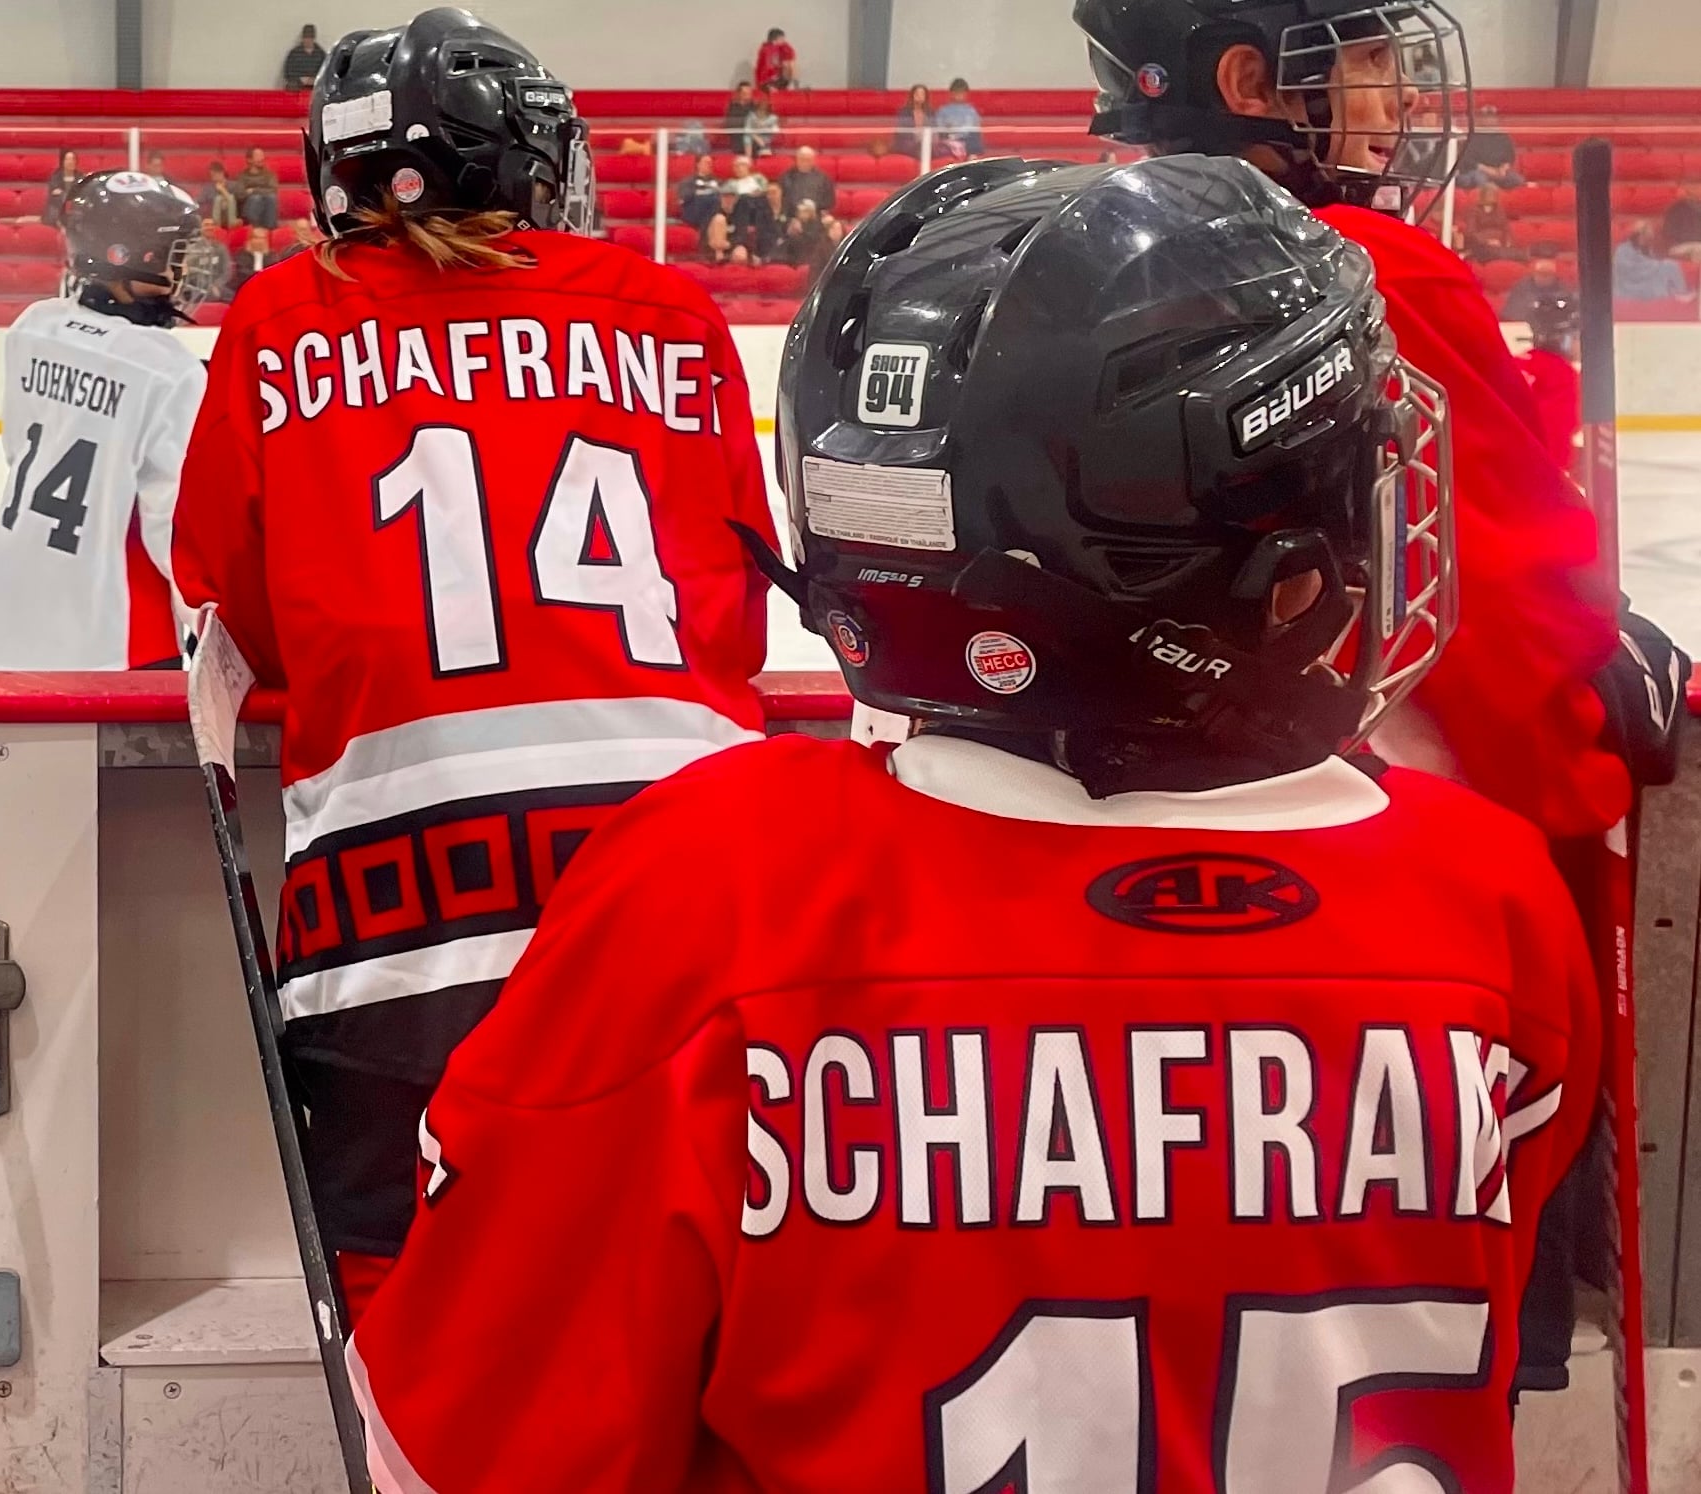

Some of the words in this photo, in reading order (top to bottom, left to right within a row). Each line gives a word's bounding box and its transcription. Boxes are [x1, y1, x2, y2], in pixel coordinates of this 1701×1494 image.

[20, 357, 127, 419] JOHNSON
[256, 317, 724, 436] SCHAFRANE
[865, 372, 914, 415] 94
[870, 354, 921, 374] SHOTT
[1, 421, 98, 556] 14
[371, 424, 687, 679] 14
[981, 653, 1028, 672] HECC
[740, 1026, 1564, 1238] SCHAFRAN
